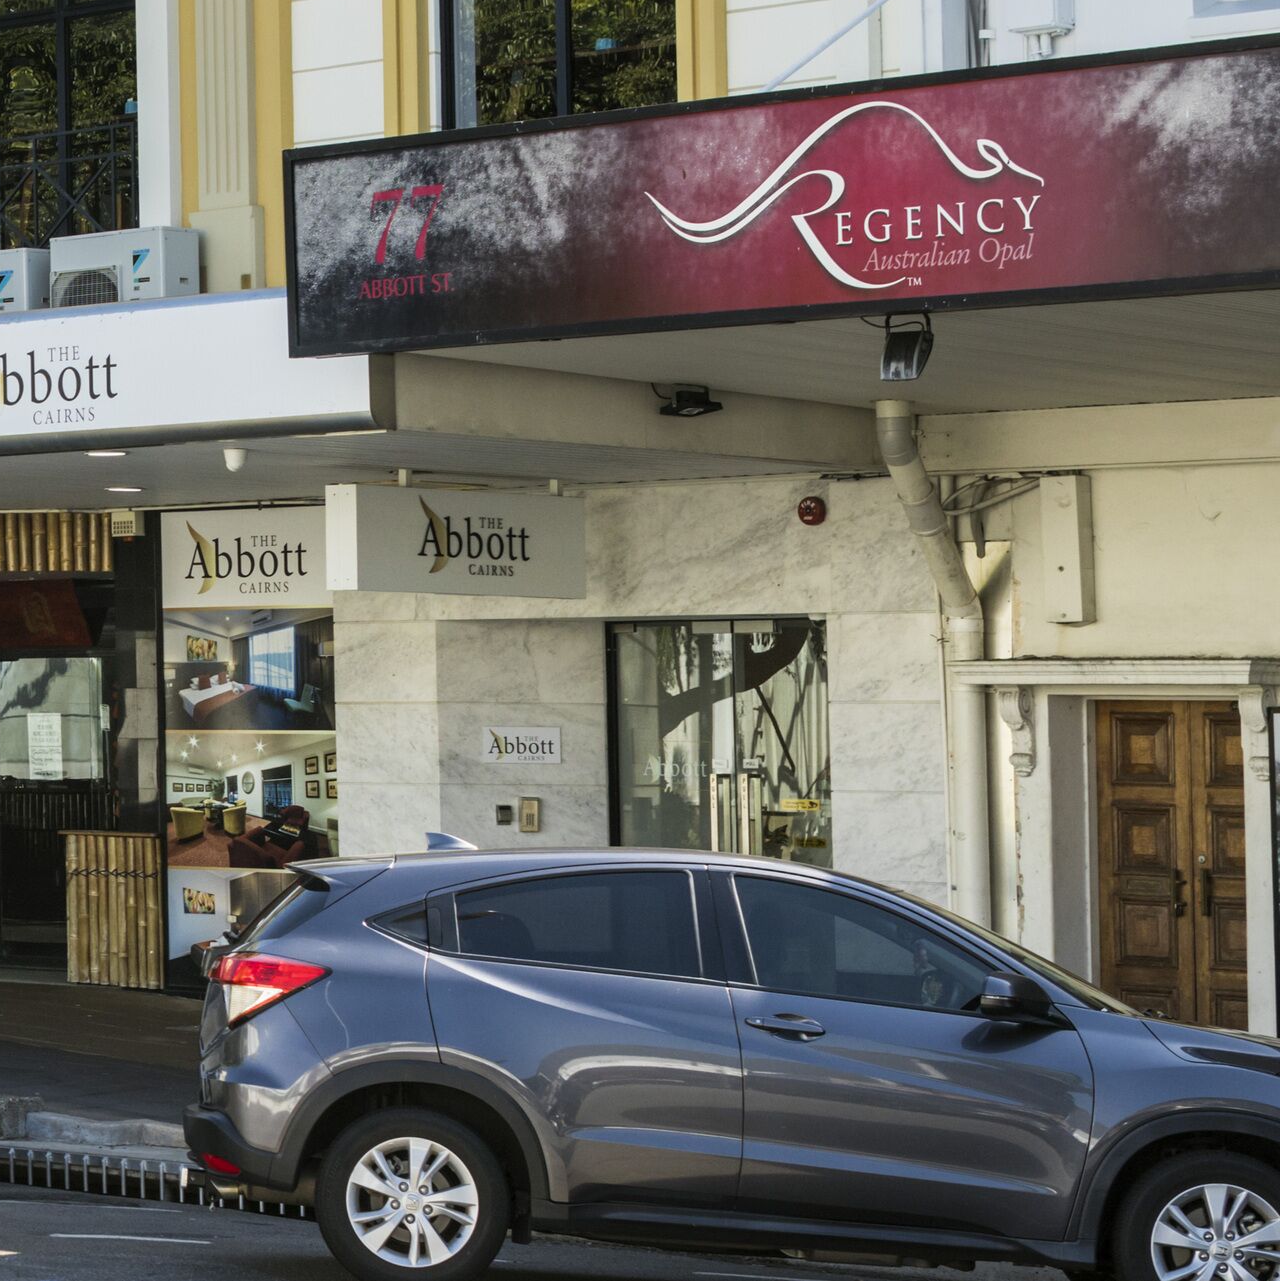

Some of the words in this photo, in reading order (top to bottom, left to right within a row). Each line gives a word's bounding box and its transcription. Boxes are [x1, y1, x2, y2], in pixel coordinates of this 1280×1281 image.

[371, 183, 445, 264] 77
[792, 169, 1041, 288] REGENCY
[862, 241, 971, 272] Australian
[978, 233, 1034, 269] Opal
[358, 274, 428, 299] ABBOTT
[431, 272, 455, 293] ST.
[48, 345, 80, 362] THE
[33, 406, 95, 425] CAIRNS
[479, 517, 504, 529] THE
[250, 535, 278, 547] THE
[417, 515, 530, 561] Abbott
[185, 537, 308, 579] Abbott
[468, 564, 515, 577] CAIRNS
[239, 581, 290, 594] CAIRNS
[488, 736, 555, 755] Abbott
